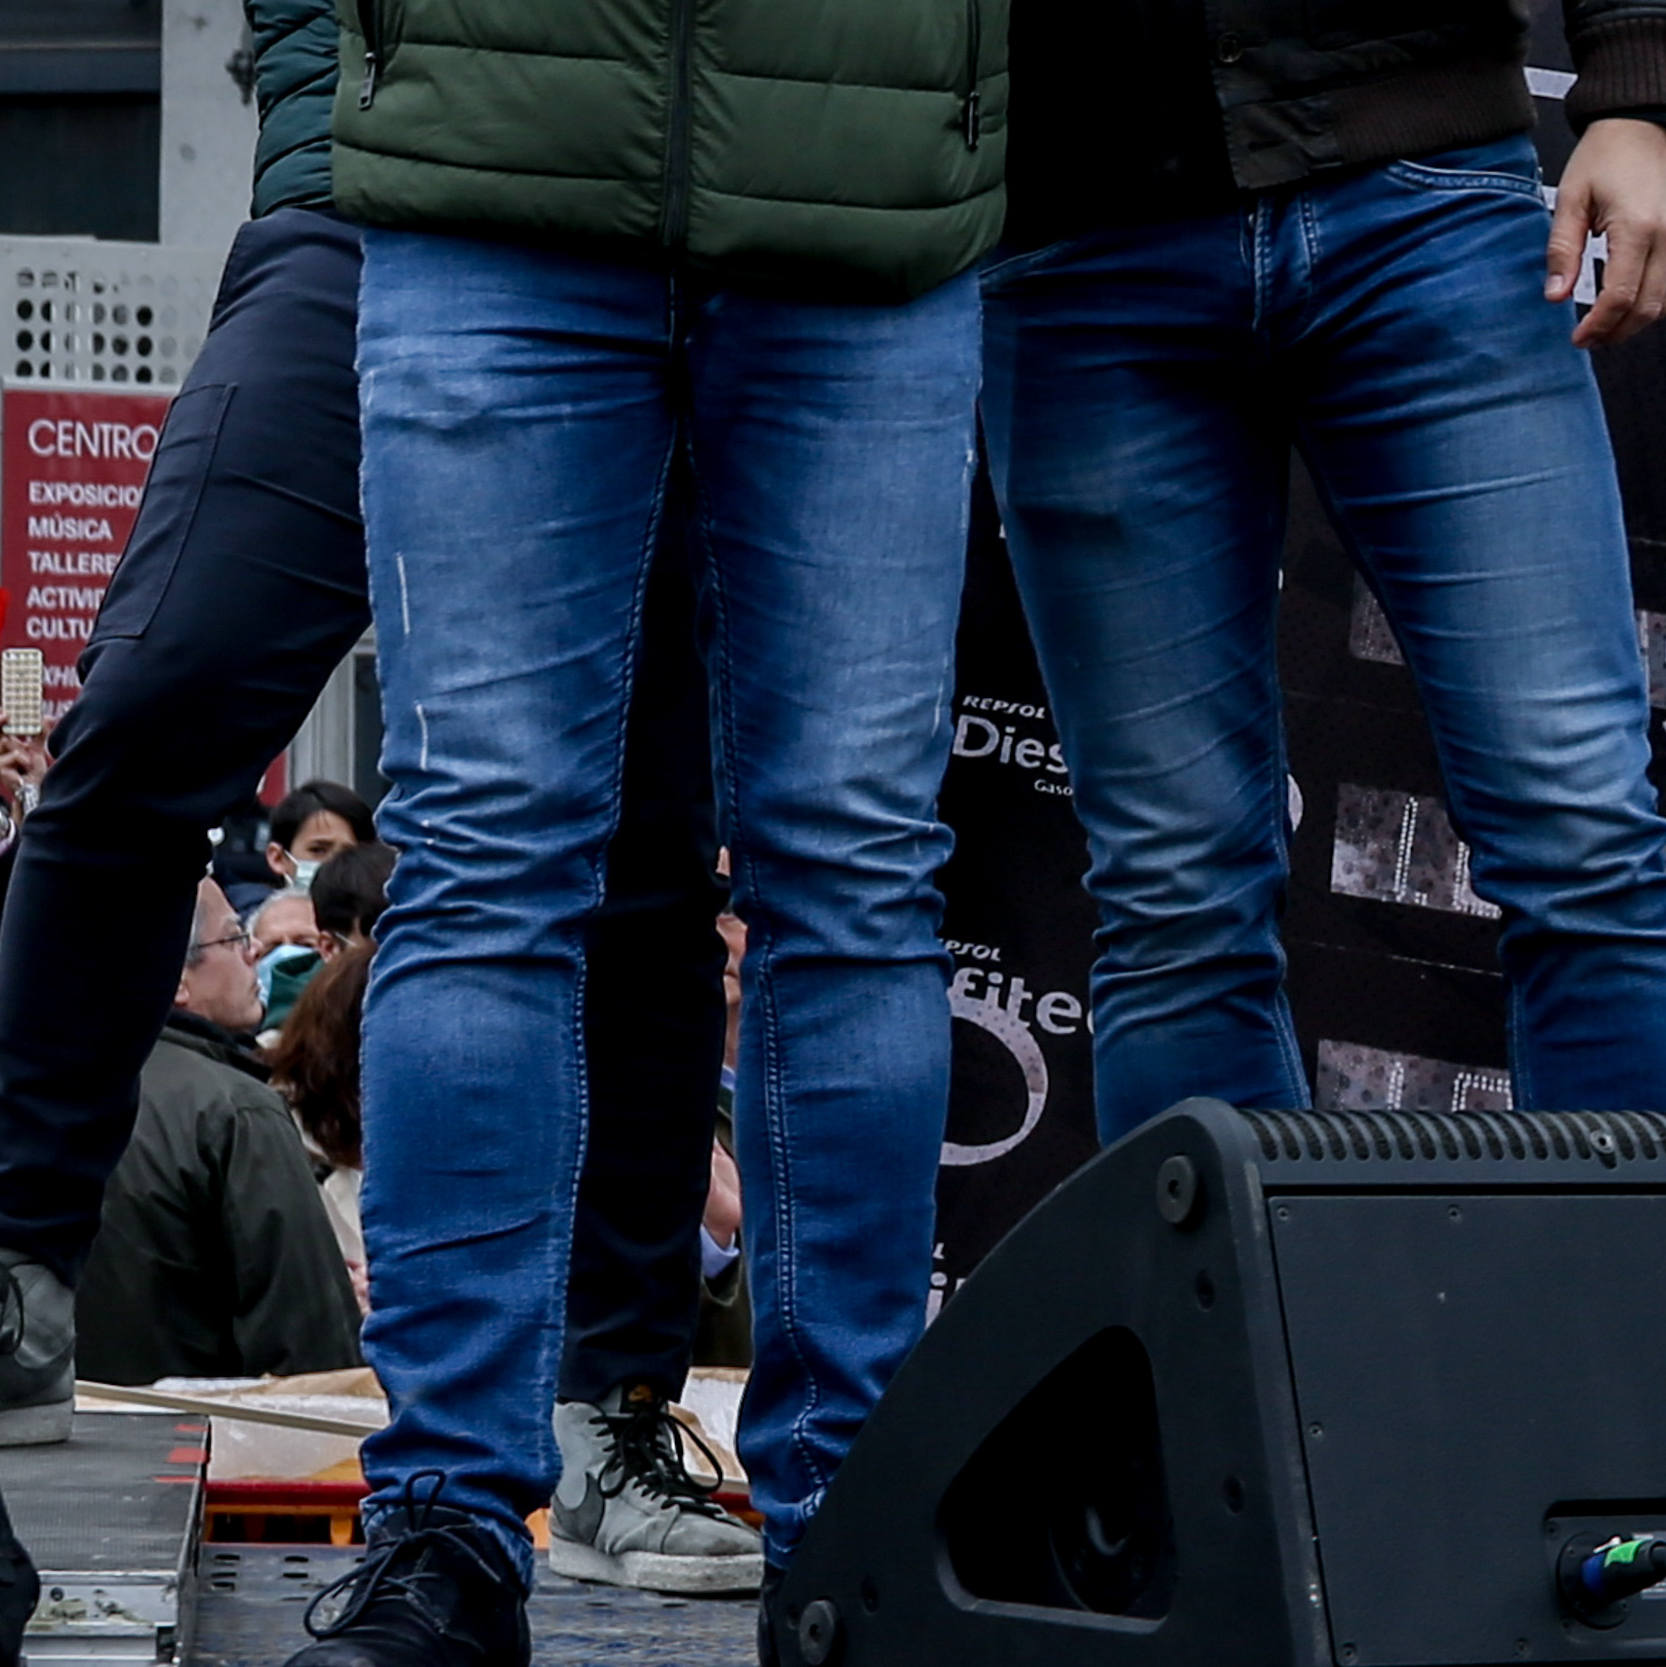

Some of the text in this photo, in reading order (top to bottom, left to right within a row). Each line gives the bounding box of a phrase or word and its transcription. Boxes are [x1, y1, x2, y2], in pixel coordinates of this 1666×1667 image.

[28, 418, 159, 461] CENTRO
[28, 550, 122, 575] TALLERE
[962, 695, 1045, 719] REPSOL
[937, 938, 1001, 962] PSOL
[946, 967, 1093, 1035] fite
